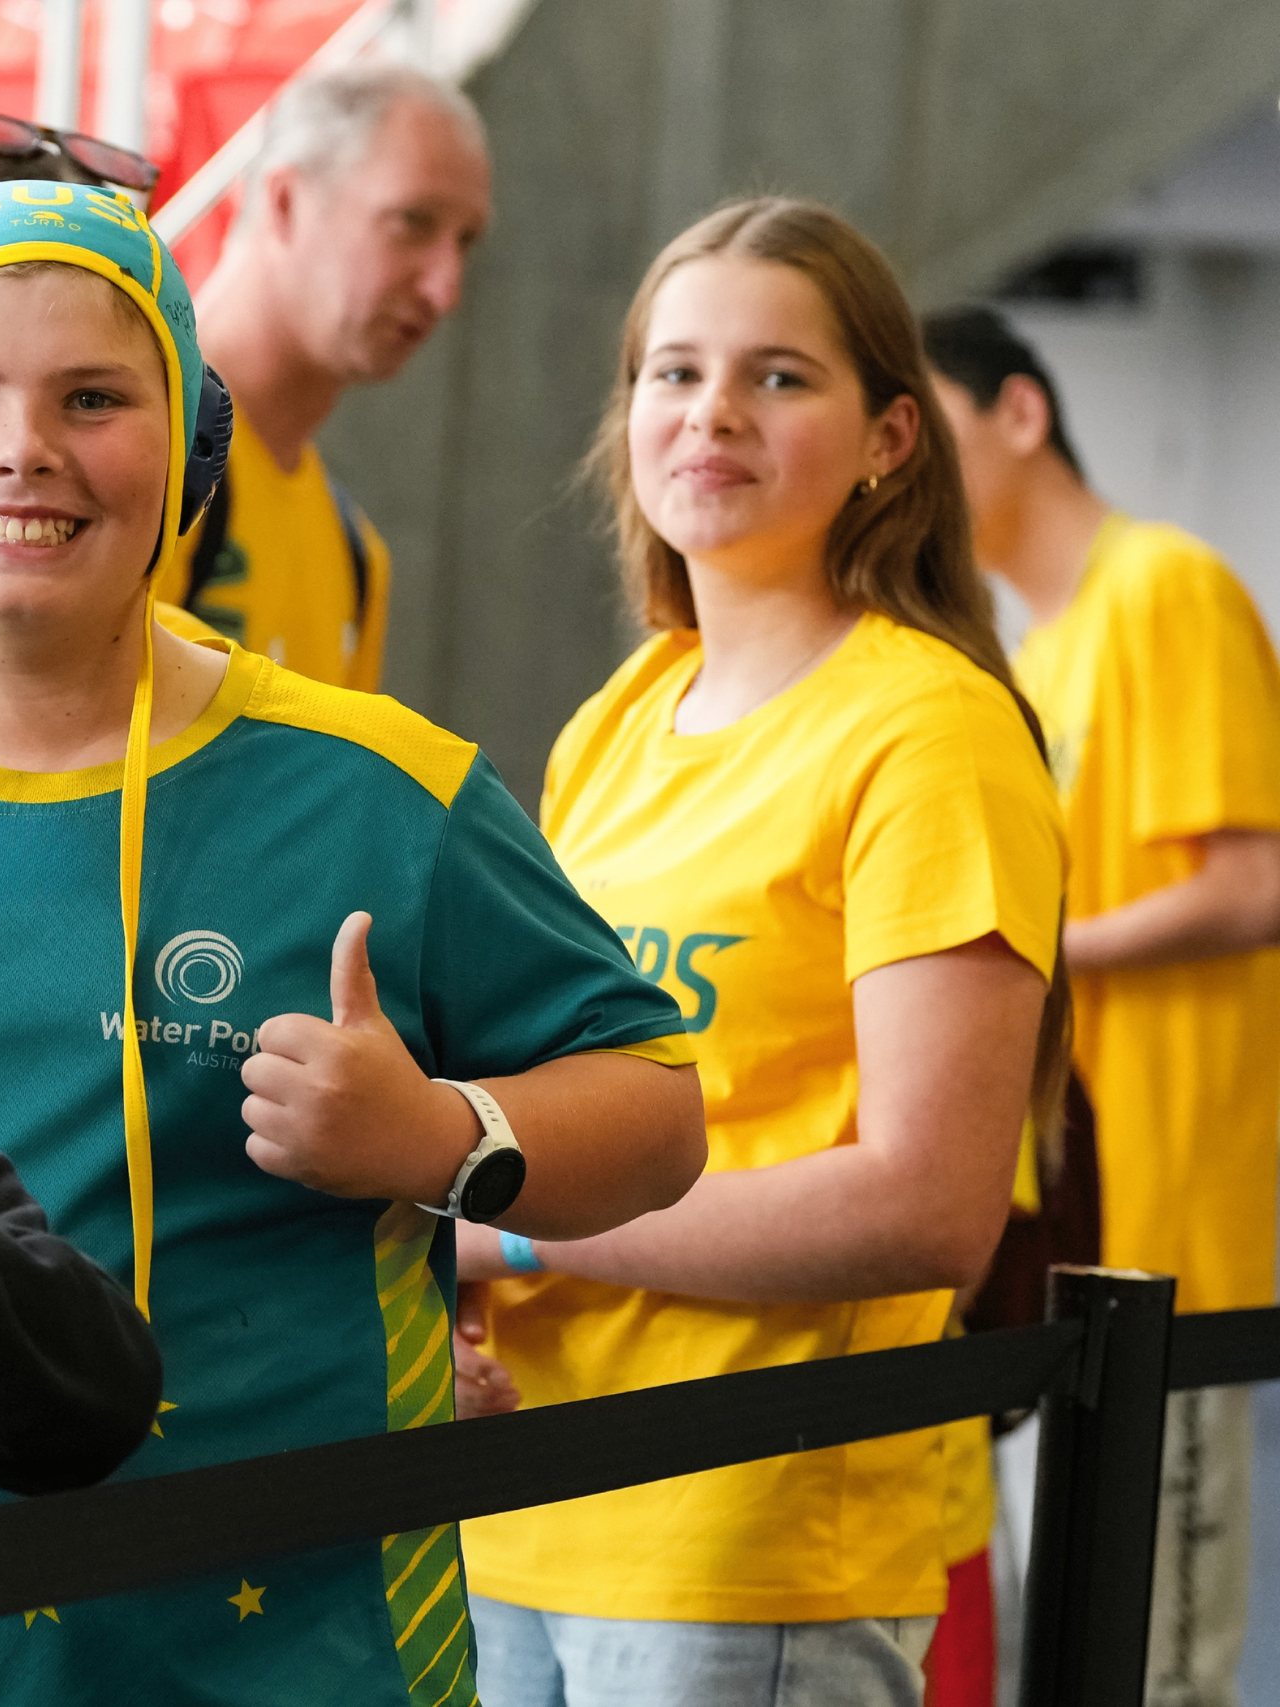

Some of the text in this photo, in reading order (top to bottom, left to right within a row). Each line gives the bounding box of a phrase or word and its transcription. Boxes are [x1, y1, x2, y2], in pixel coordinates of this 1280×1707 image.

[10, 218, 82, 232] TURBO
[100, 1011, 262, 1055] Water Pol
[186, 1051, 243, 1071] AUSTR
